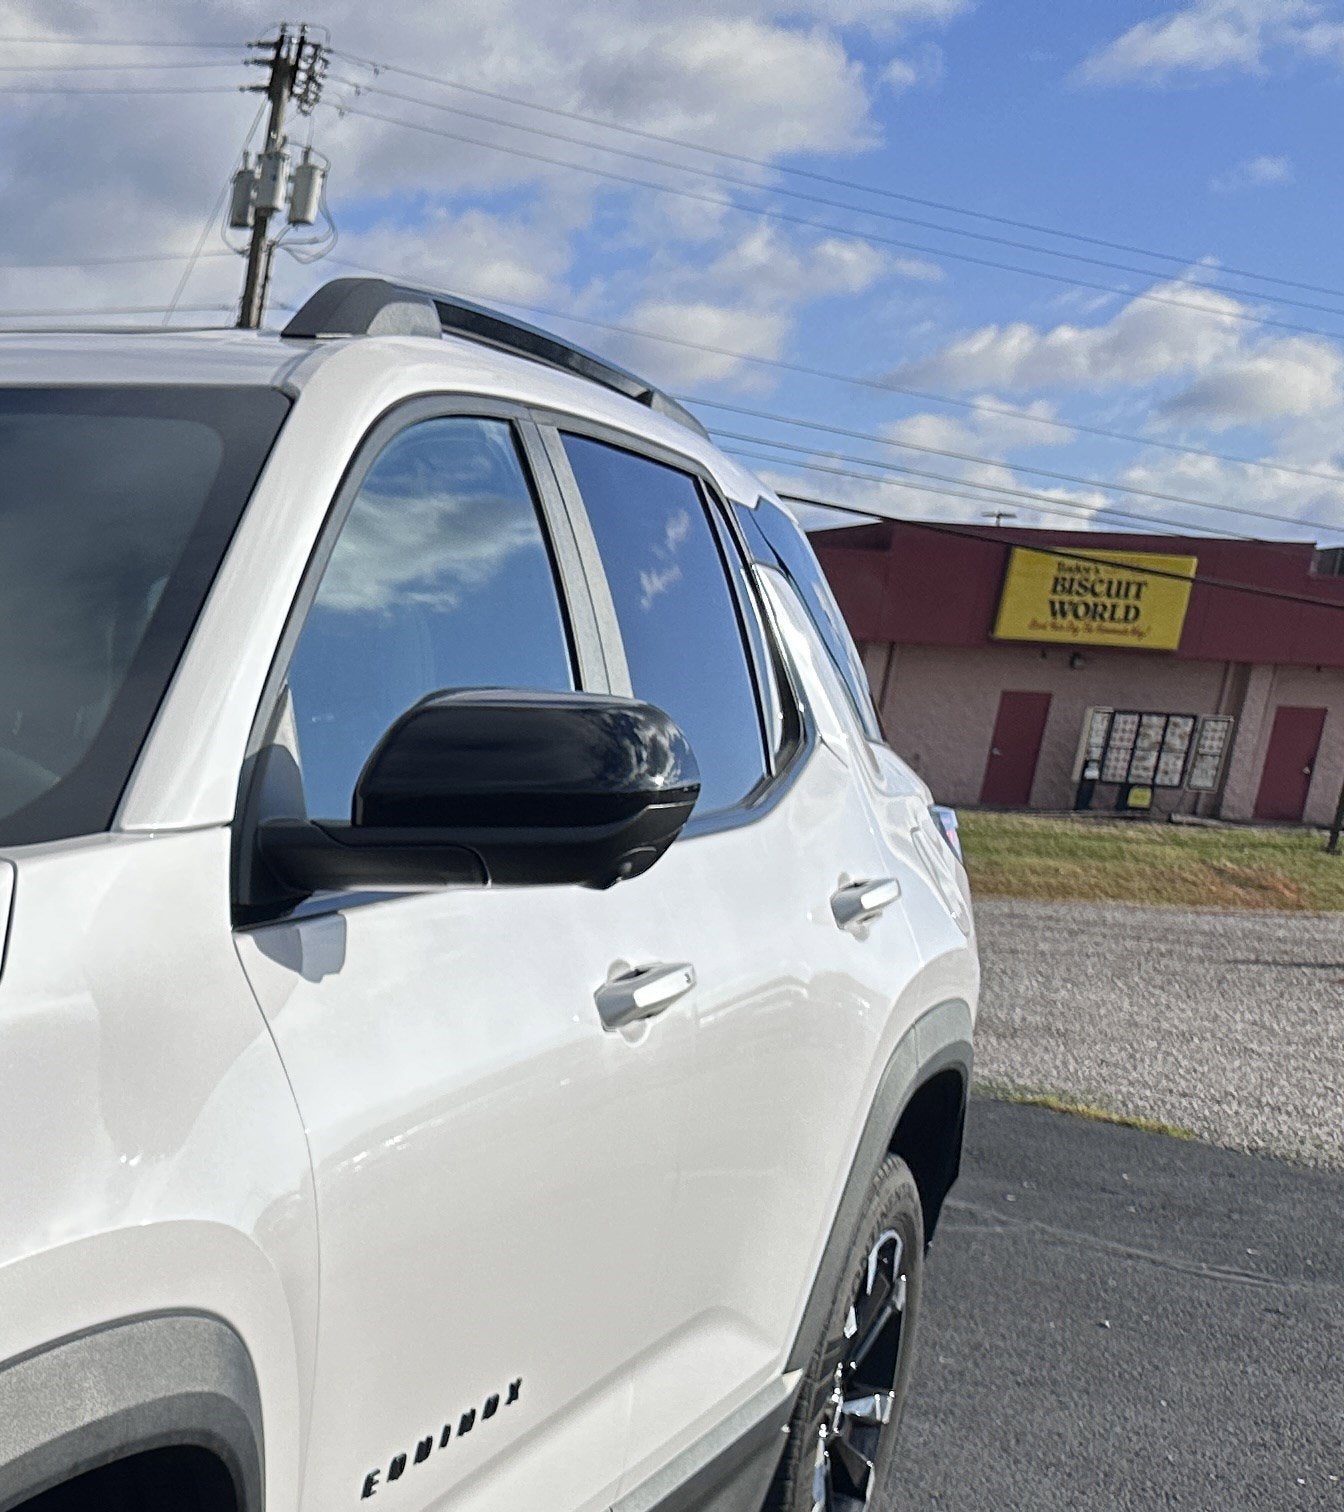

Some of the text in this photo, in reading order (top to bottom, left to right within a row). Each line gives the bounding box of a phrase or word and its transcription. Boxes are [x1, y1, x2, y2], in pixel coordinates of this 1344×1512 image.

[1052, 576, 1147, 601] BISCUIT
[1048, 600, 1141, 623] WORLD
[360, 1377, 523, 1501] EQUINOX
